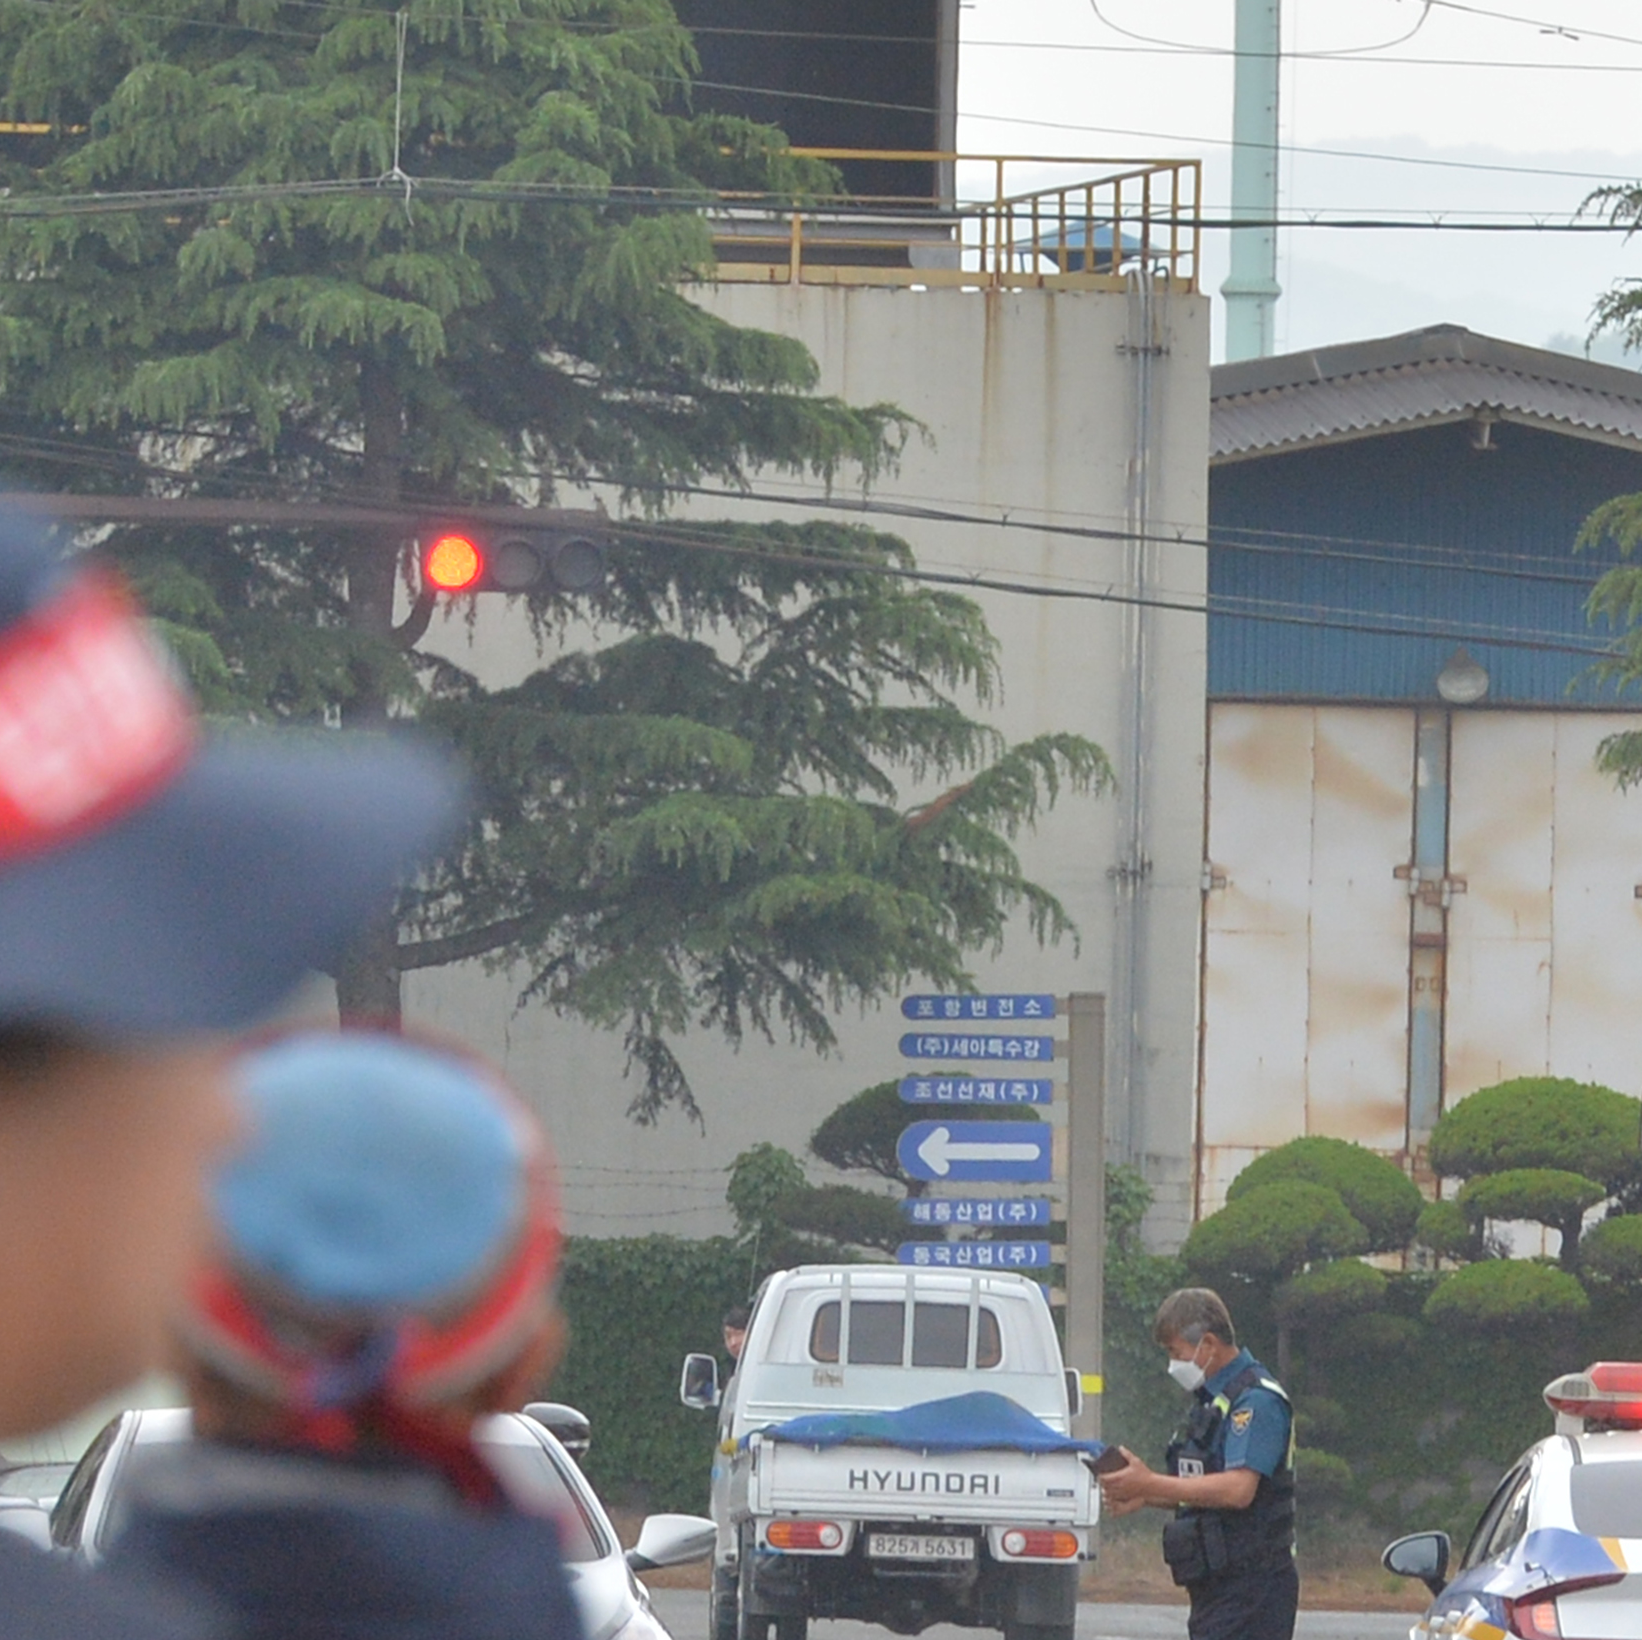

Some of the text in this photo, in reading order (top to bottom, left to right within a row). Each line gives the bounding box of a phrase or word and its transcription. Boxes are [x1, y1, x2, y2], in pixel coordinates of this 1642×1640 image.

[914, 1081, 1039, 1101] 조선선재(주)
[848, 1469, 1000, 1495] HYUNDAI
[924, 1539, 966, 1556] 5631
